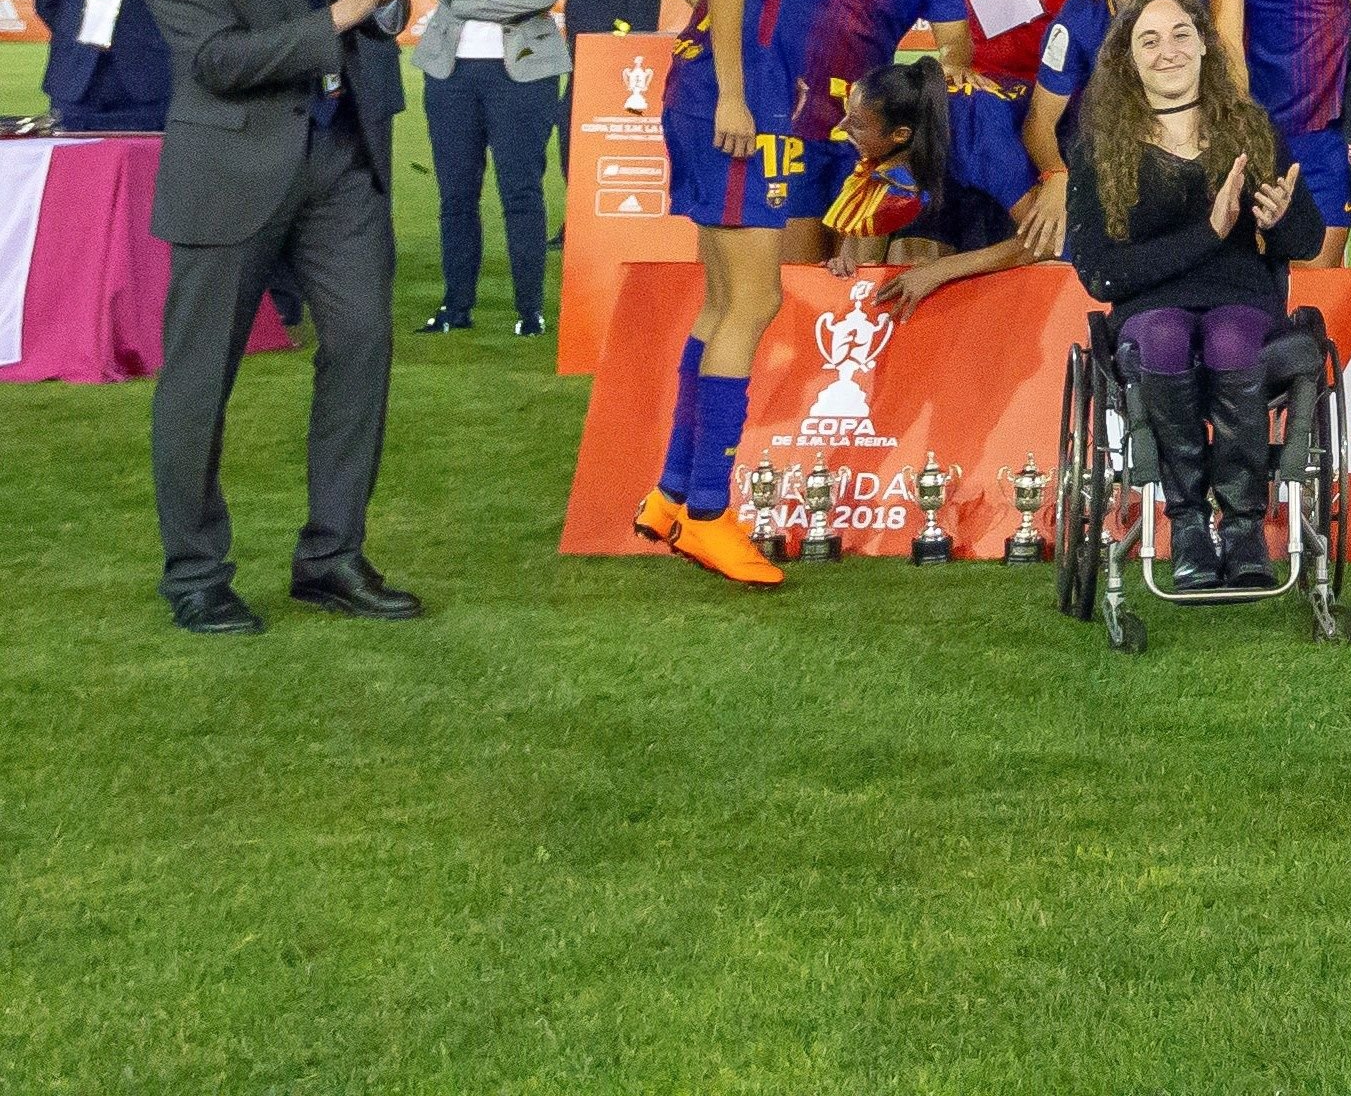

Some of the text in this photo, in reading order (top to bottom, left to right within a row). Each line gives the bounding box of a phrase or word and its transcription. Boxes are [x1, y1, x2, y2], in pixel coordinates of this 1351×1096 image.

[755, 134, 805, 178] 12
[799, 418, 876, 436] COPA
[771, 435, 793, 447] DE
[829, 435, 850, 447] LA
[831, 505, 907, 530] 2018
